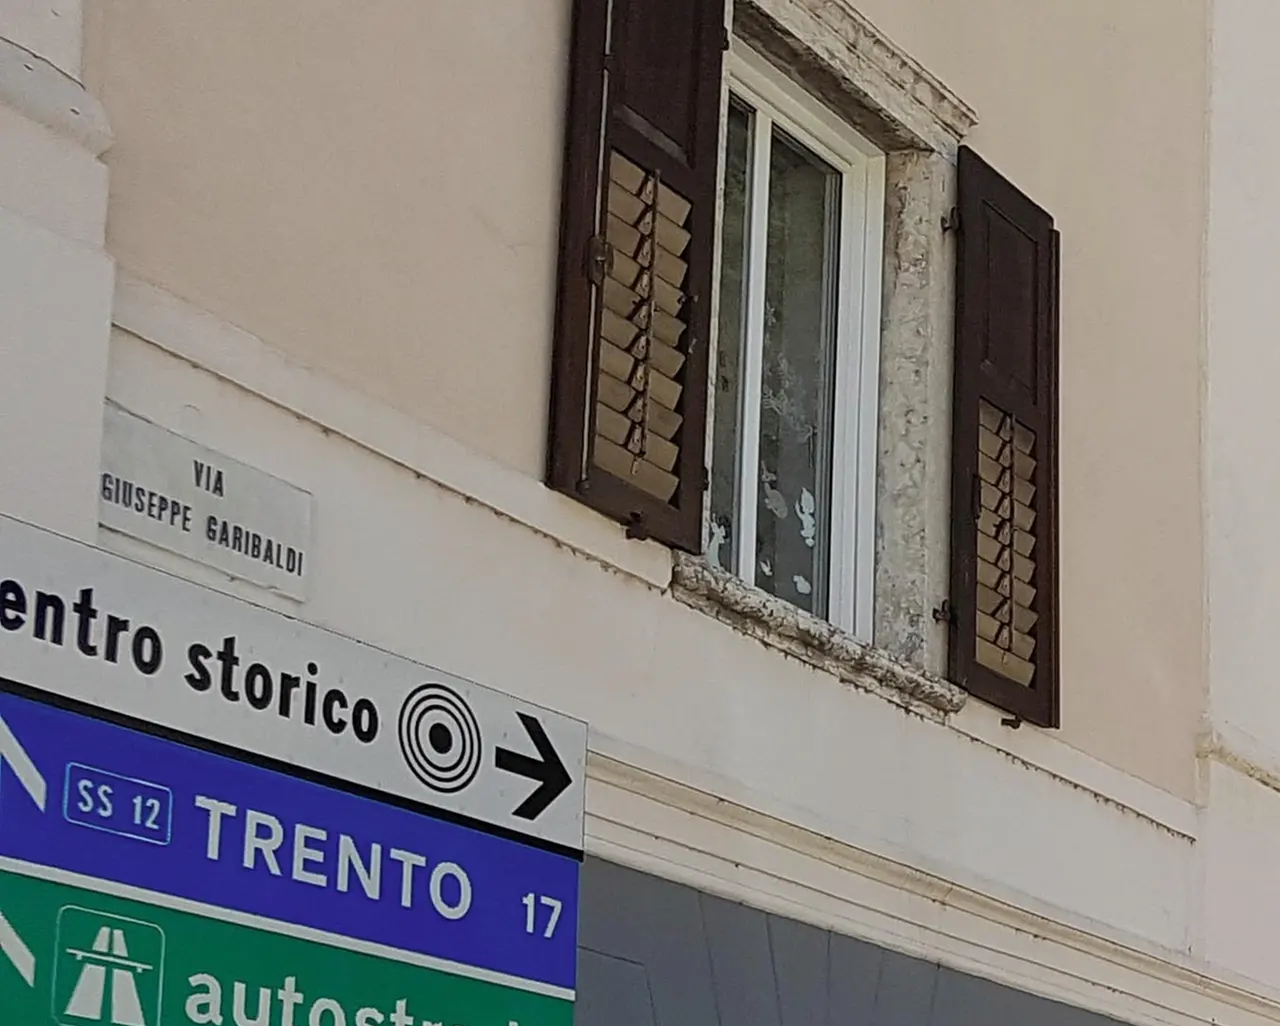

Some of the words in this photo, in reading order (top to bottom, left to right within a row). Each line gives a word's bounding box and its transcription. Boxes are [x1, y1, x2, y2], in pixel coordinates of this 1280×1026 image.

[101, 473, 191, 532] GIUSEPPE
[206, 516, 303, 576] GARIBALDI
[193, 460, 225, 498] VIA
[184, 636, 378, 743] storico
[77, 779, 114, 818] SS
[132, 796, 161, 830] 12
[194, 796, 472, 920] TRENTO
[521, 892, 563, 938] 17
